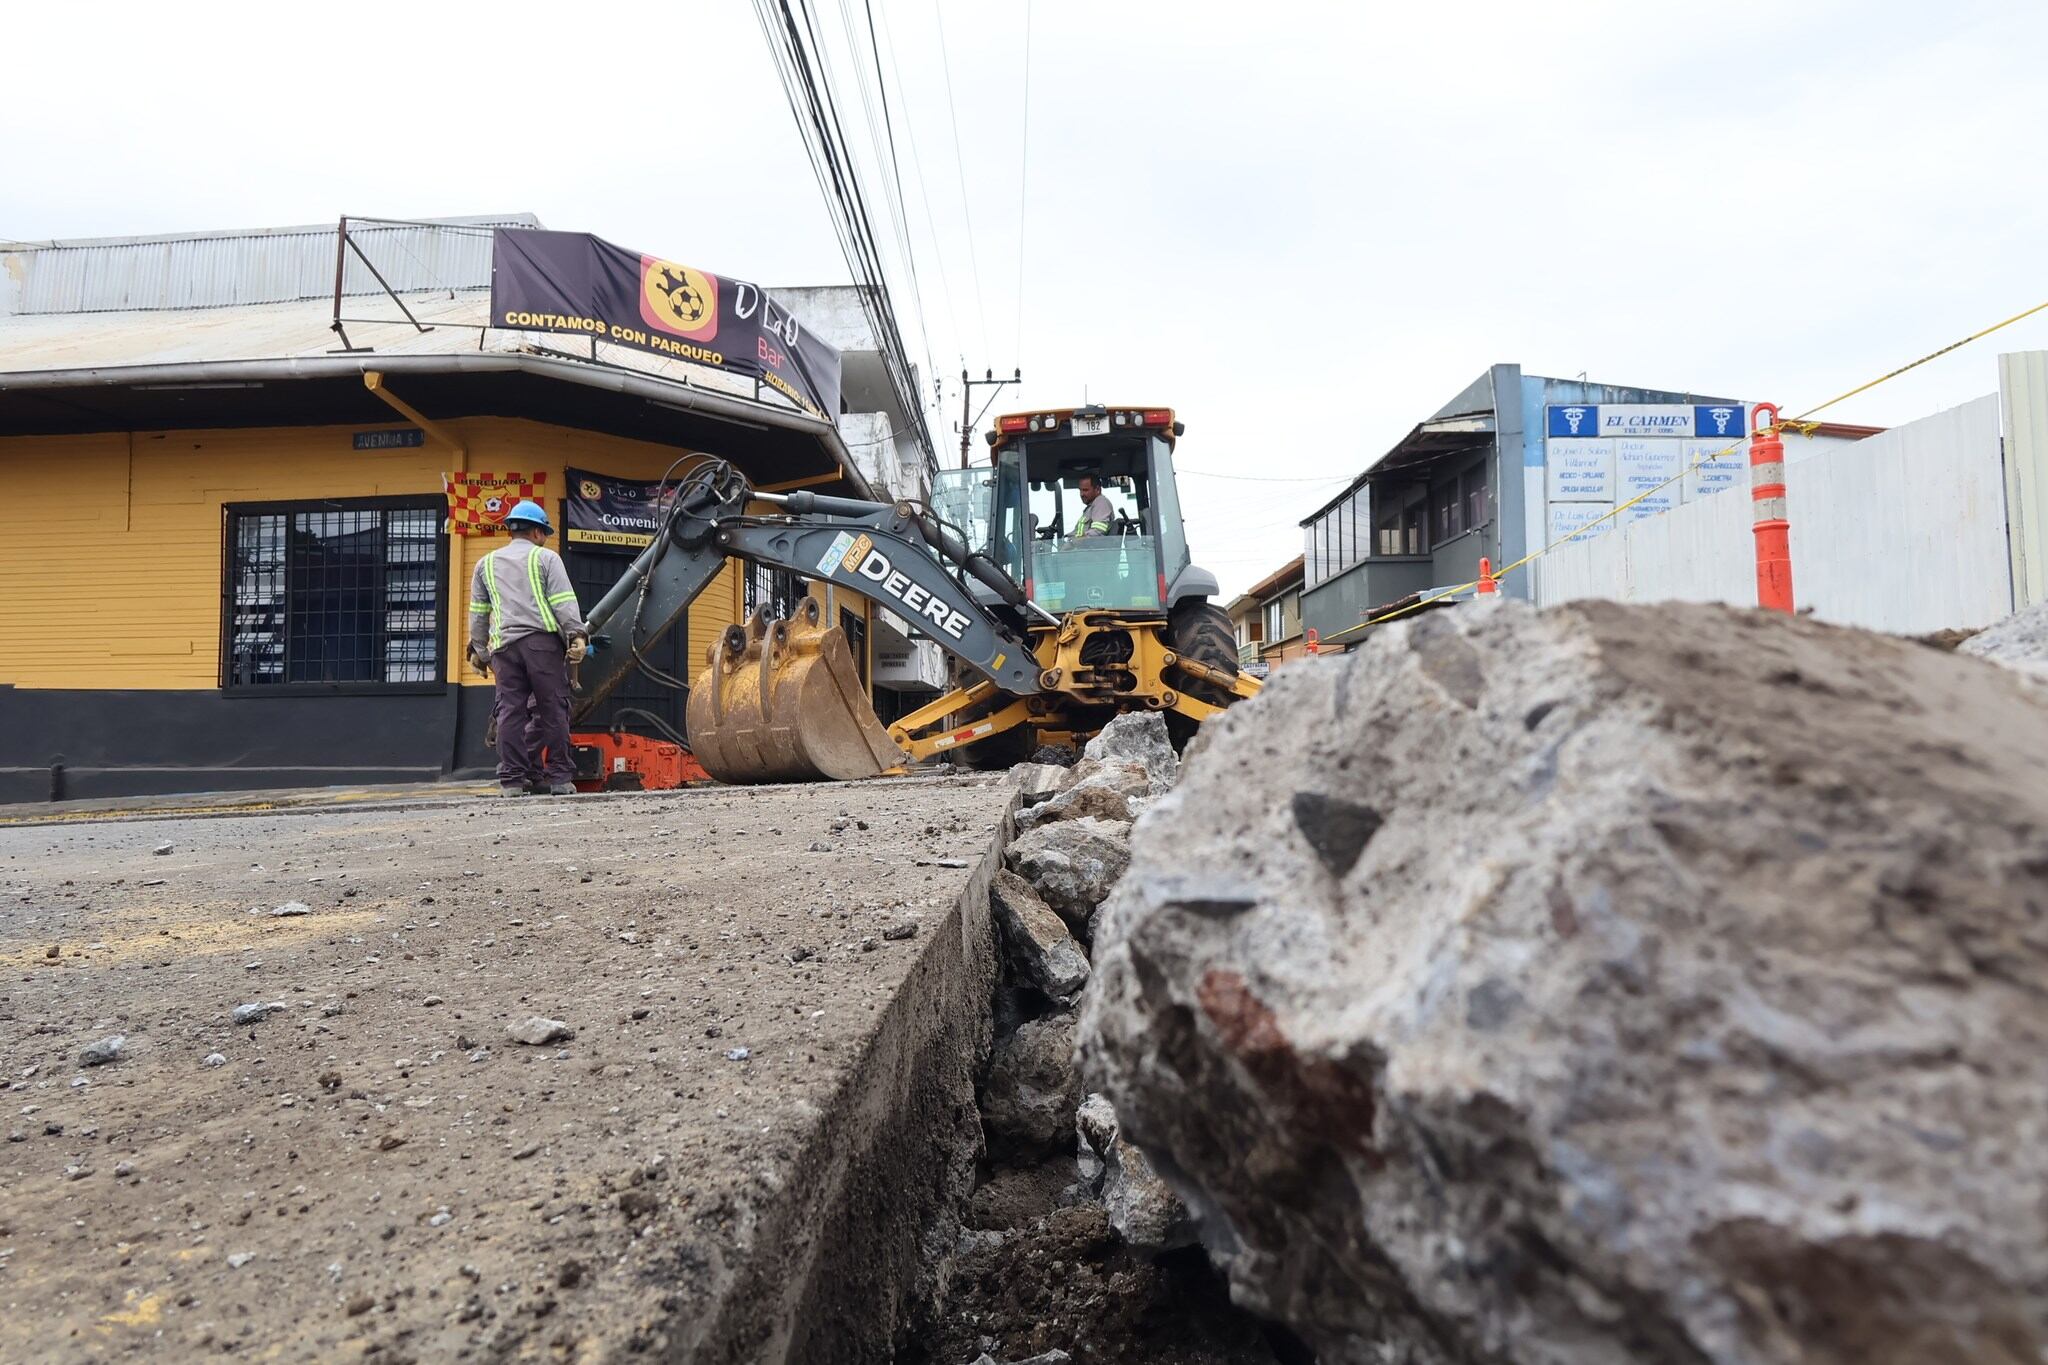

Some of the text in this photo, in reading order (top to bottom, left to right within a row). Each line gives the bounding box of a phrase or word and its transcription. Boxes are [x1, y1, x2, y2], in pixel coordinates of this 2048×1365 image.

[505, 311, 723, 366] CONTAMOS CON PARQUEO
[758, 336, 785, 369] Bar
[1606, 415, 1691, 426] EL CARMEN
[460, 478, 527, 487] HEREDIANO
[458, 520, 511, 533] DE CORA
[580, 531, 647, 547] Parqueo para
[858, 549, 971, 638] DEERE
